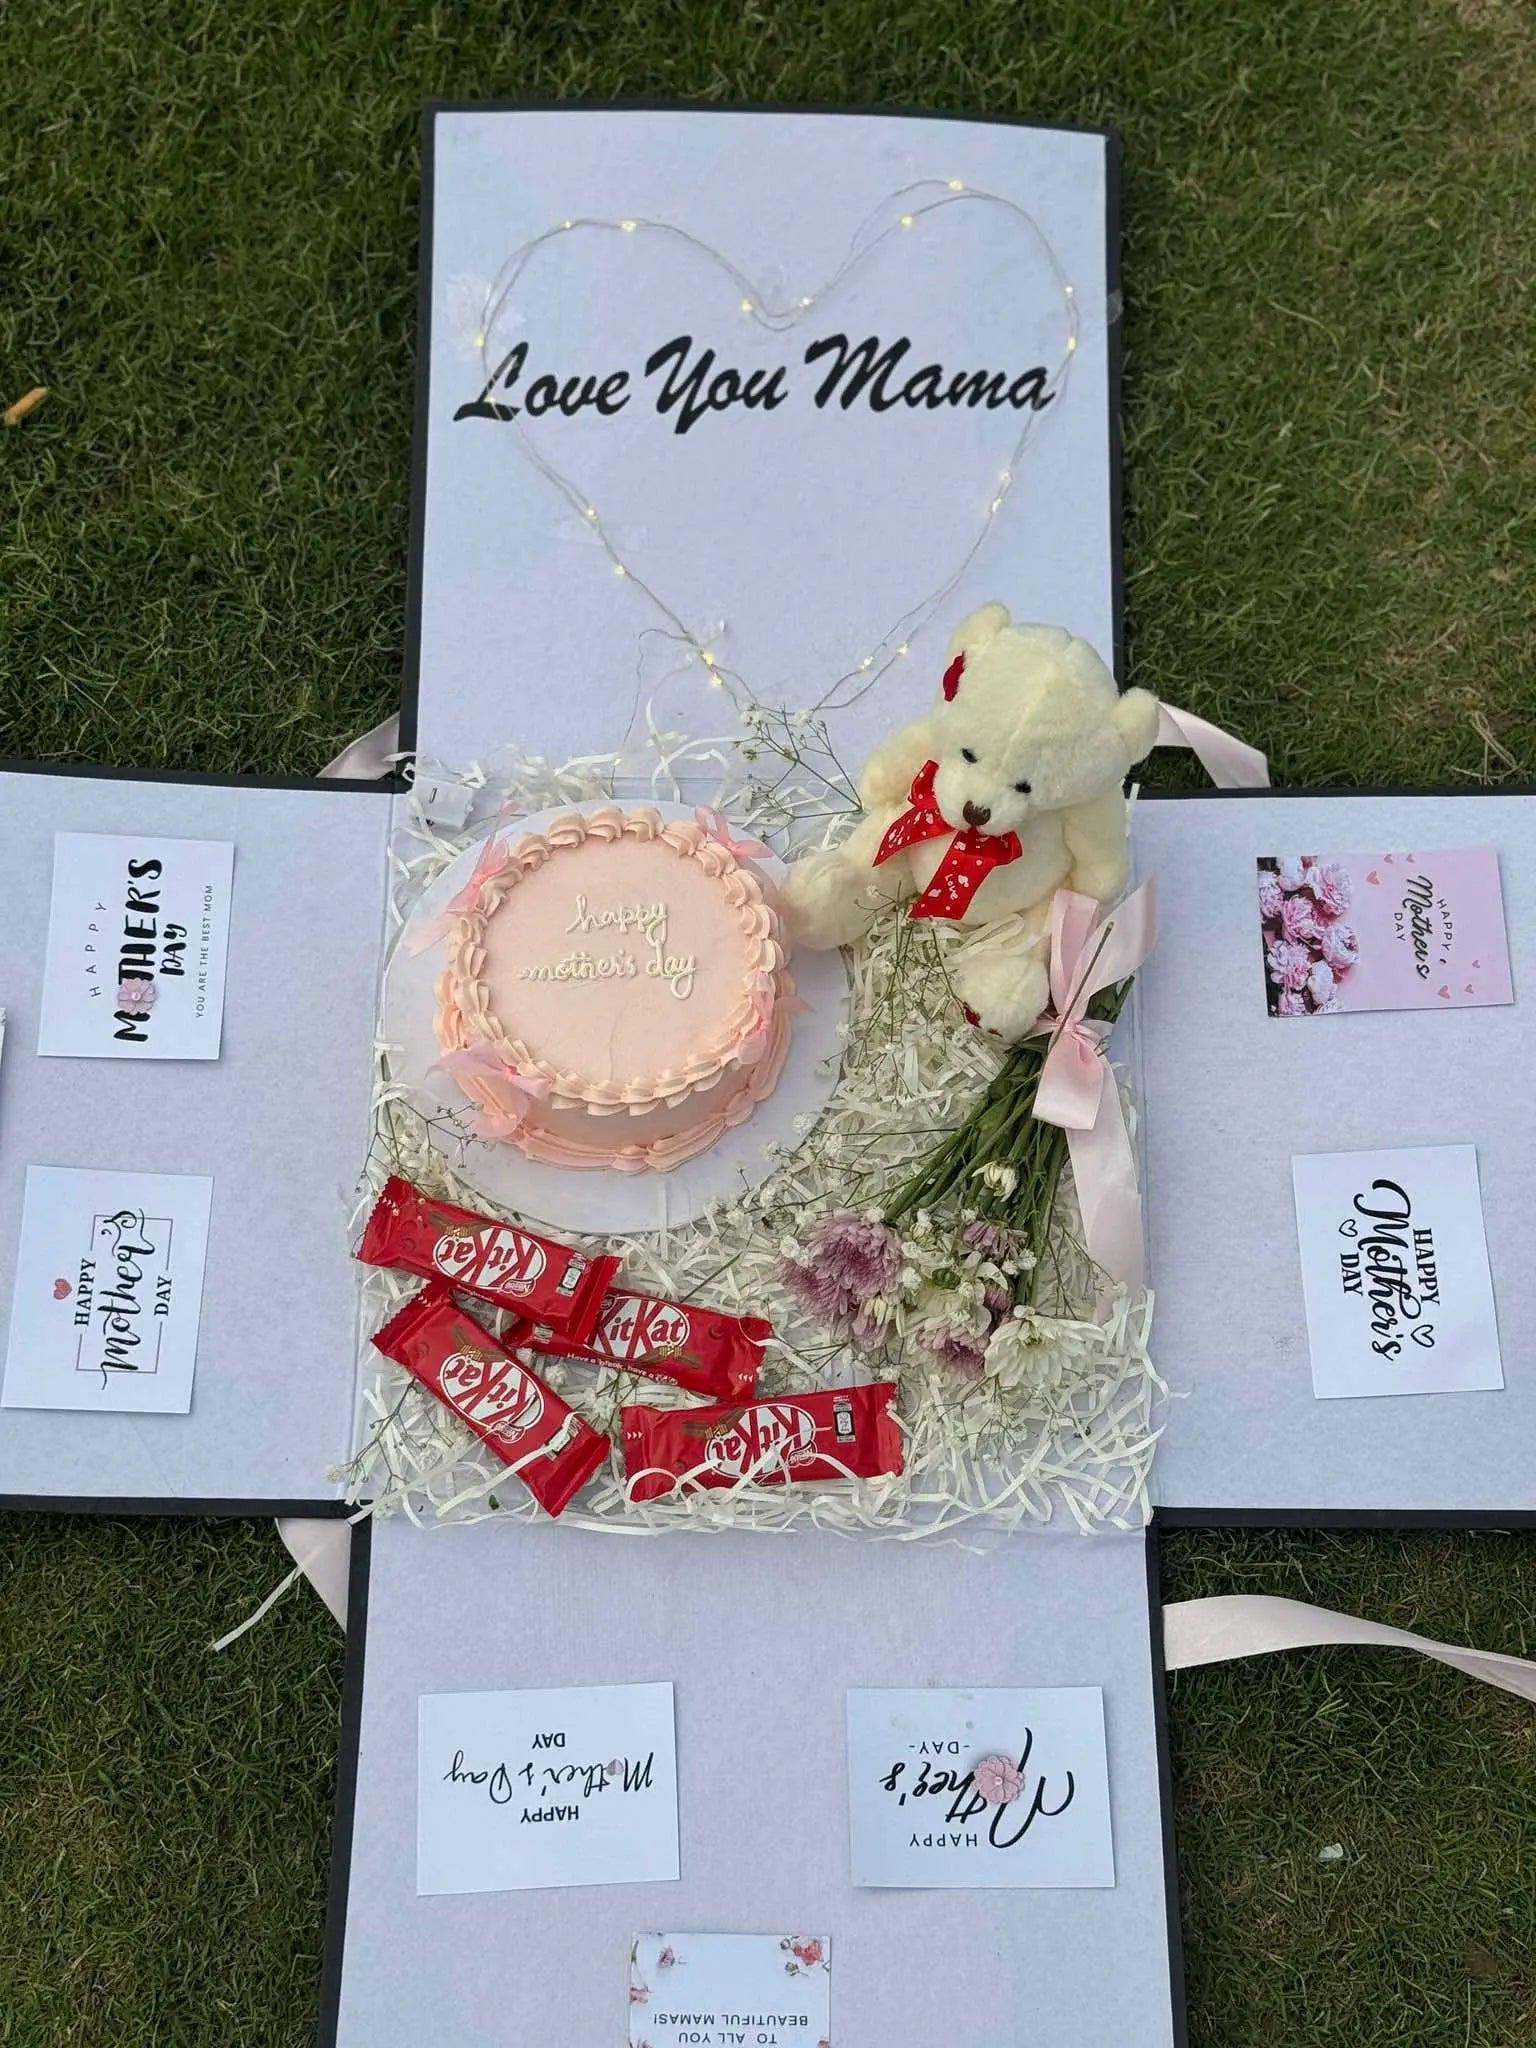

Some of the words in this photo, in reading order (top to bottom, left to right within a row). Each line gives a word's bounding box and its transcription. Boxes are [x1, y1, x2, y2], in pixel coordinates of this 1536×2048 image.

[453, 341, 632, 422] Love
[645, 335, 789, 434] You
[804, 333, 1057, 412] Mama
[203, 884, 213, 913] MOM
[565, 894, 668, 949] happy
[201, 917, 211, 943] BEST
[1393, 912, 1407, 942] DAY
[1436, 898, 1453, 952] HAPPY
[84, 901, 108, 998] HAPPY
[113, 858, 163, 1043] MTHER'S
[159, 923, 188, 976] DAY
[199, 946, 209, 967] THE
[516, 948, 639, 983] mother's
[646, 938, 697, 1000] day
[197, 970, 208, 994] ARE
[195, 996, 206, 1019] YOU
[434, 1226, 546, 1288] KitKat
[1340, 1252, 1364, 1297] DAY
[1353, 1179, 1421, 1362] Mother's
[1412, 1227, 1441, 1307] HAPPY
[74, 1258, 97, 1327] HAPPY
[154, 1275, 173, 1317] DAY
[586, 1297, 684, 1360] KitKat
[443, 1357, 534, 1424] KitKat
[531, 1732, 566, 1750] DAY
[443, 1750, 513, 1804] Day
[517, 1751, 654, 1798] Mther's
[878, 1726, 1075, 1849] Mther's
[520, 1804, 580, 1824] HAPPY
[909, 1832, 978, 1848] HAPPY
[652, 2013, 715, 2025] MAMAS!
[678, 2031, 711, 2044] YOU
[717, 2032, 746, 2044] ALL
[722, 2014, 809, 2026] BEAUTIFUL
[756, 2032, 778, 2044] TO
